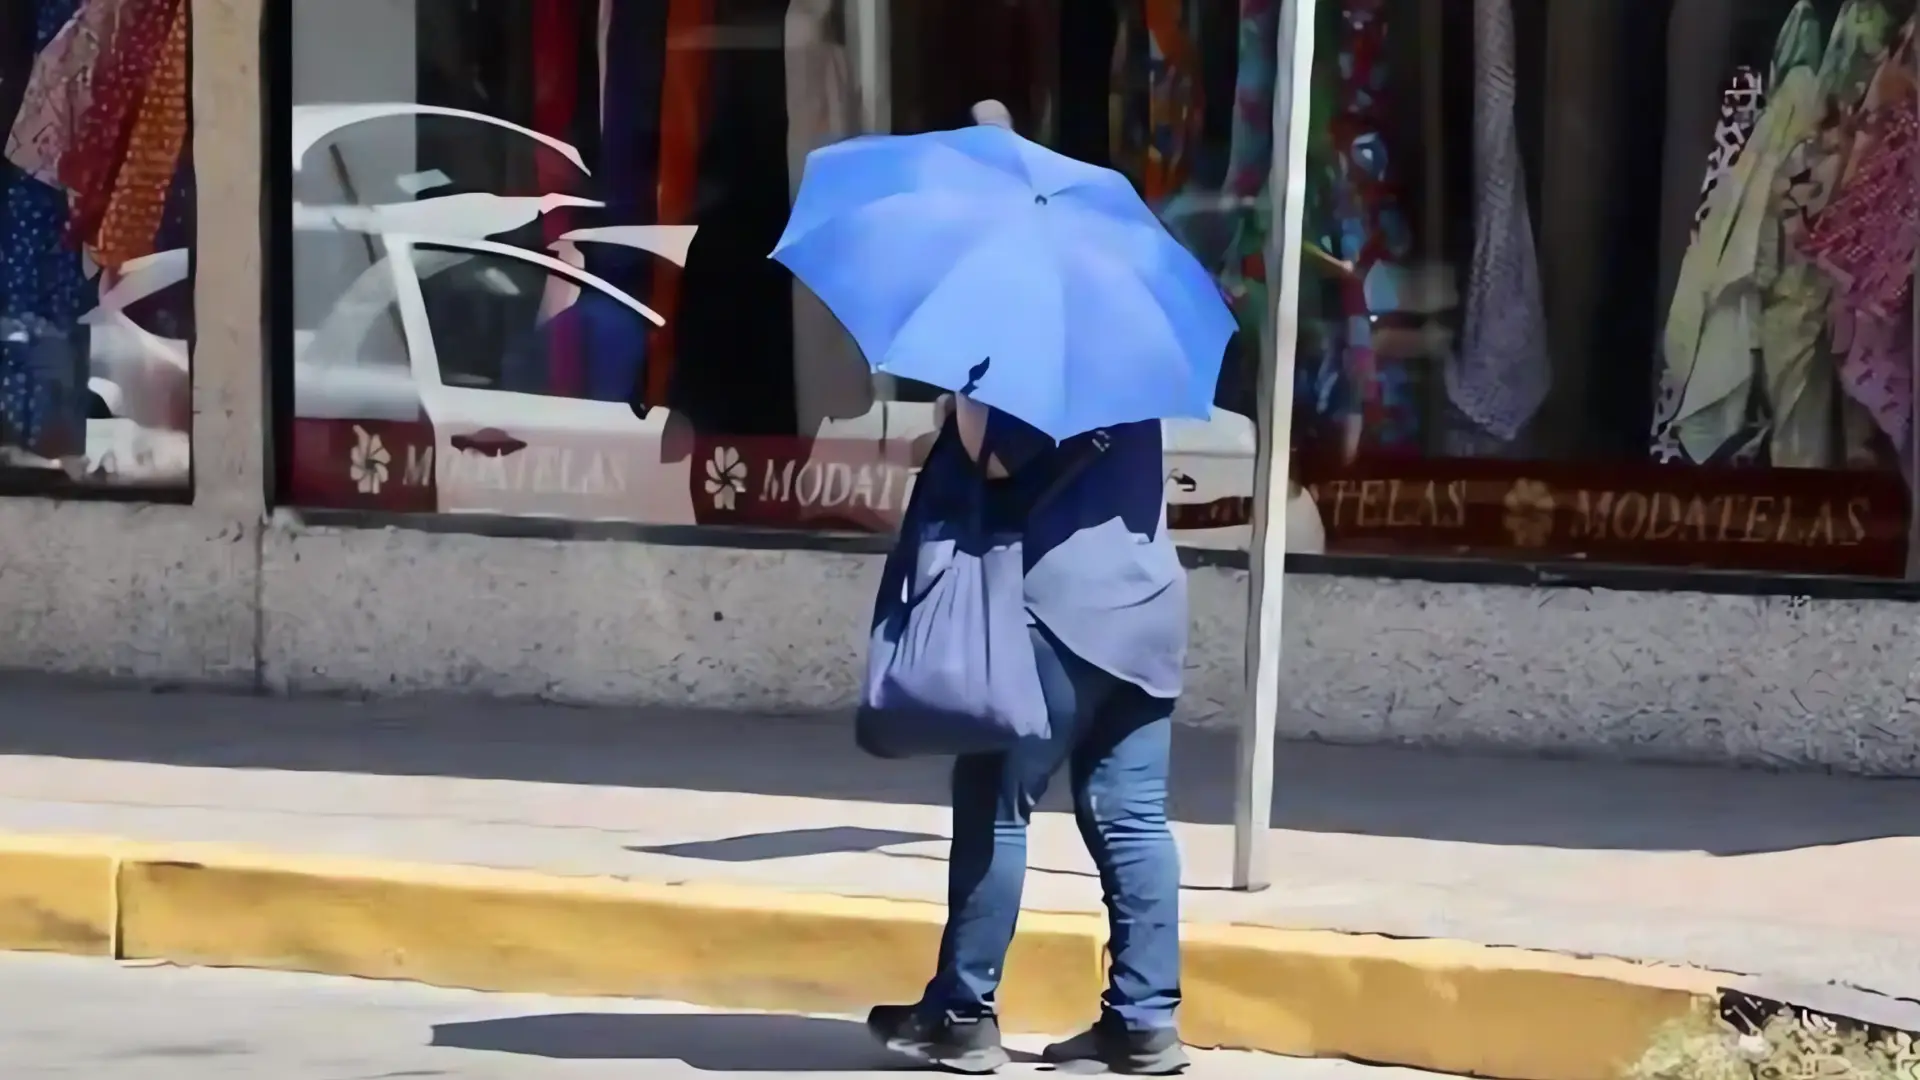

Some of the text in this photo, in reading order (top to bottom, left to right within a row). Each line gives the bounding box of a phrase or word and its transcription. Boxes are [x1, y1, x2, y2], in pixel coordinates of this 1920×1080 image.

[757, 457, 923, 512] MODAT
[1309, 479, 1468, 527] TELAS
[1569, 489, 1870, 546] MODATELAS
